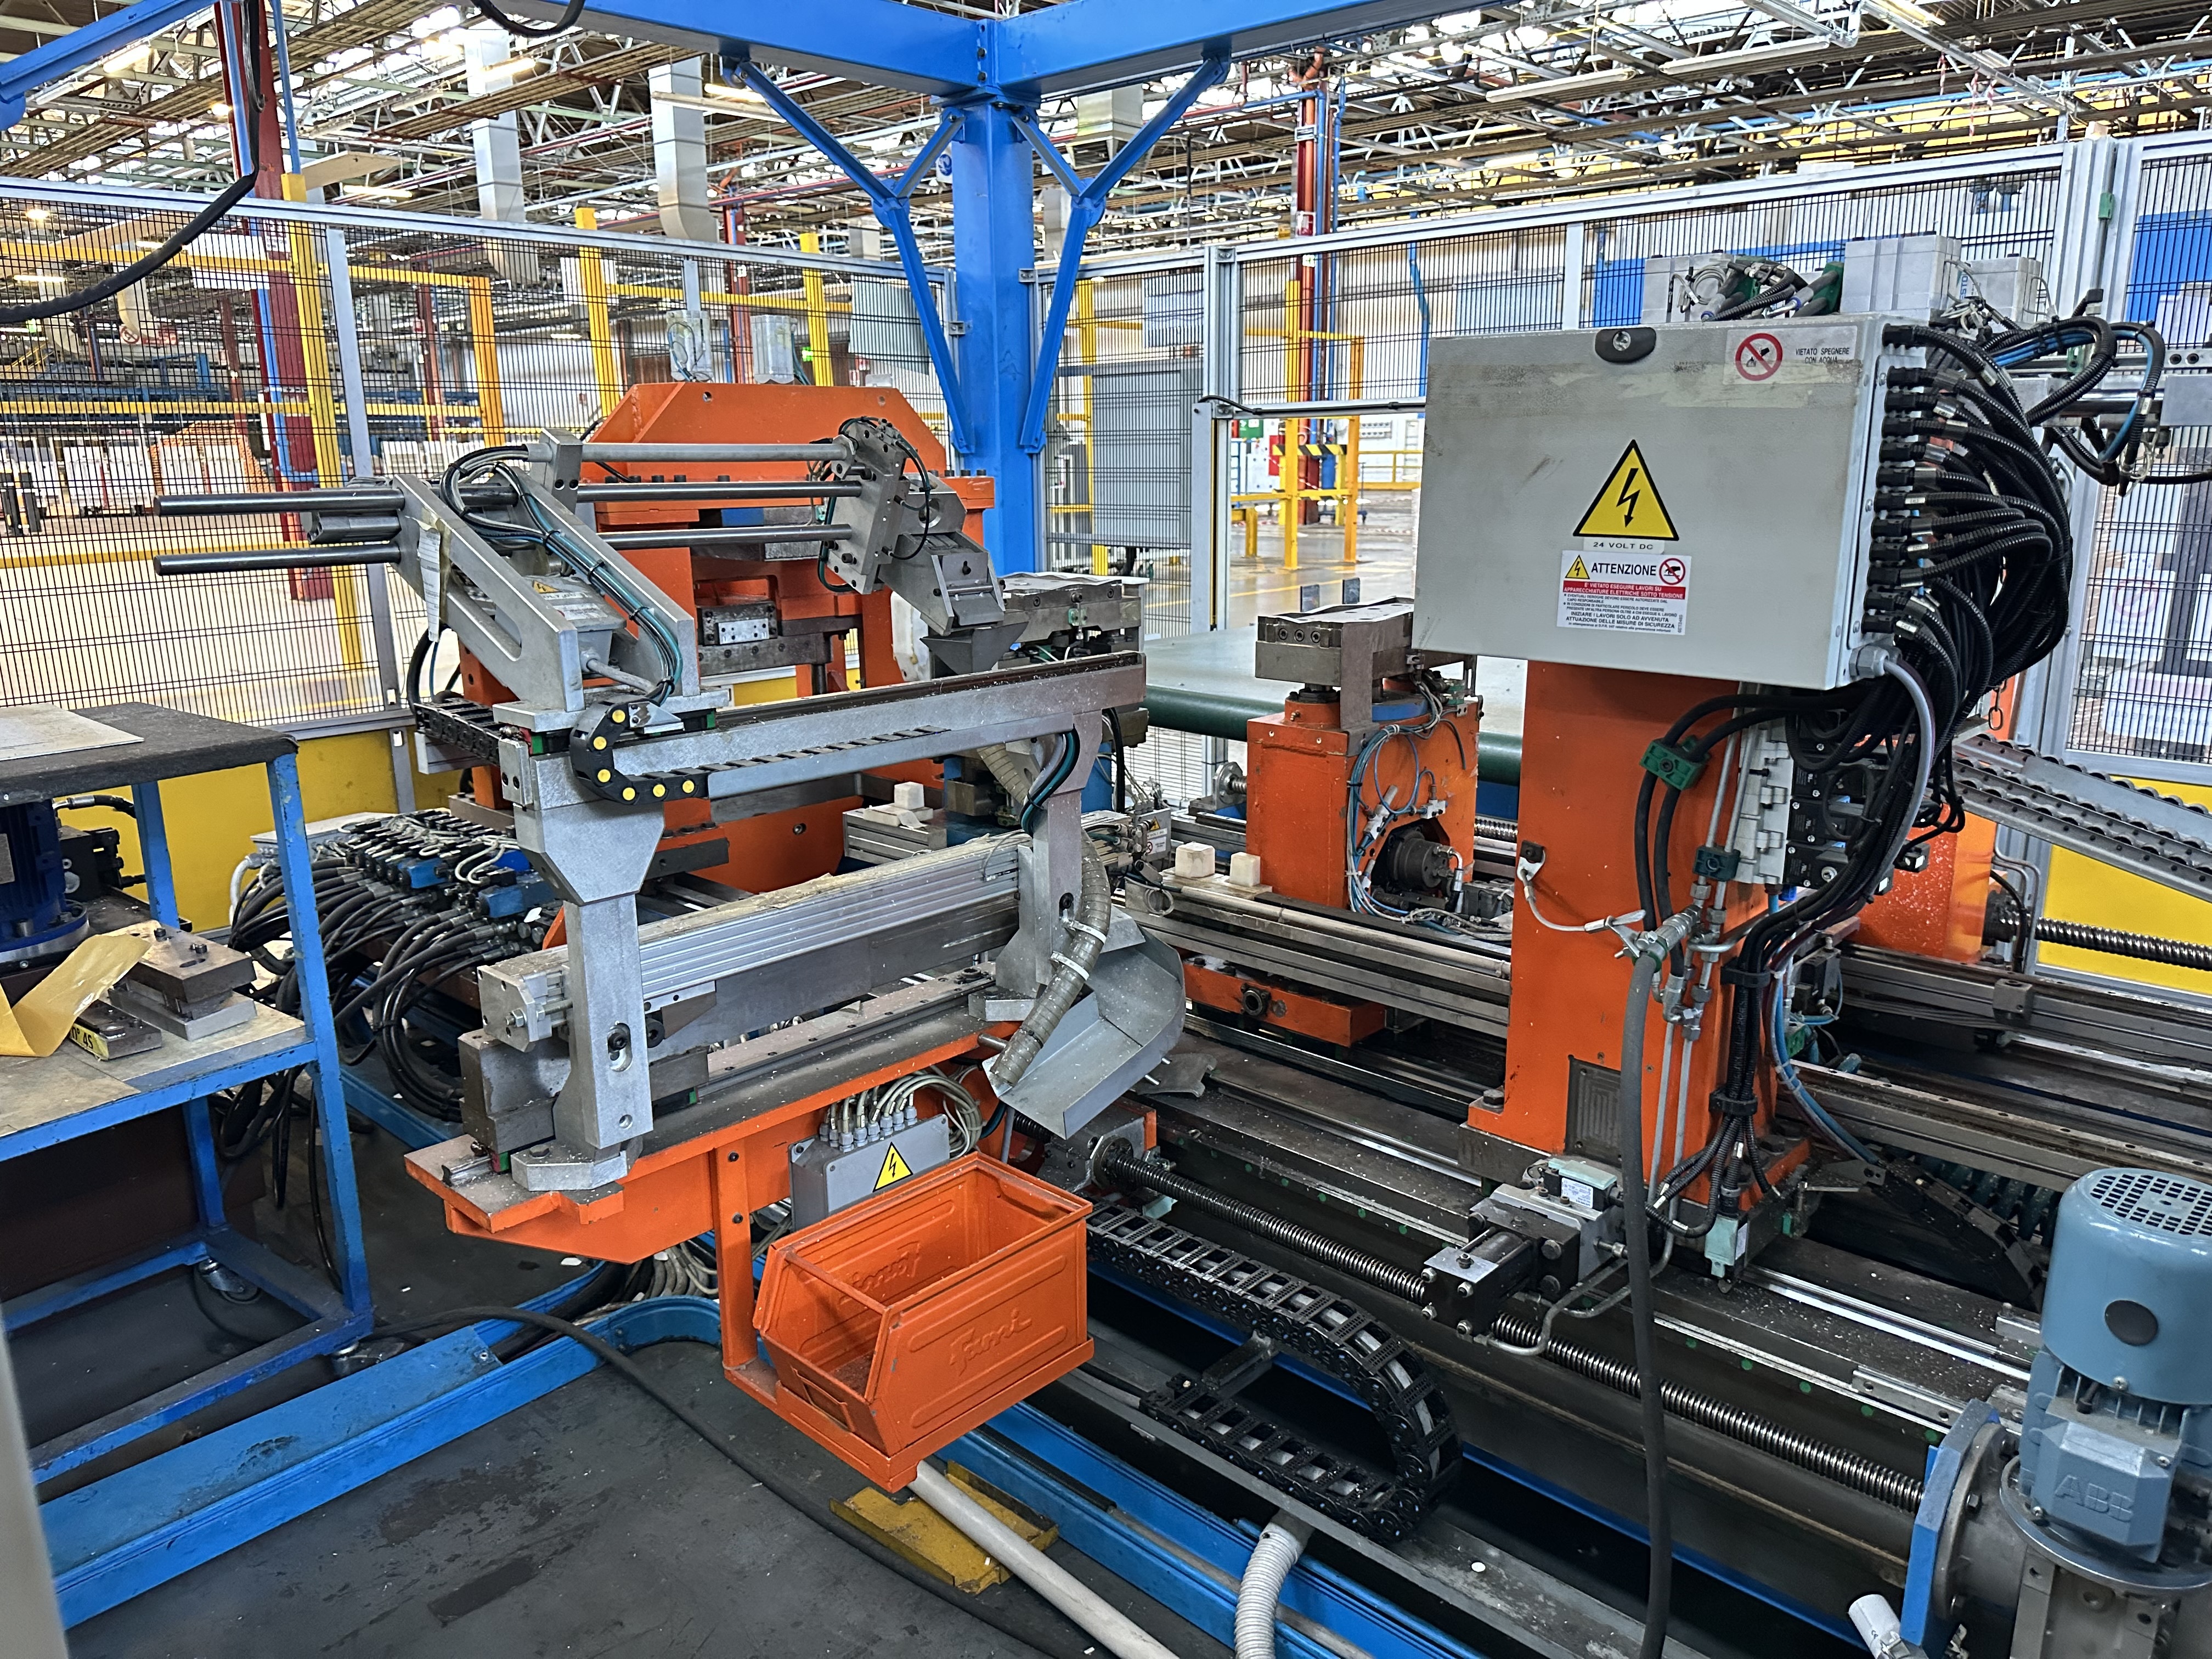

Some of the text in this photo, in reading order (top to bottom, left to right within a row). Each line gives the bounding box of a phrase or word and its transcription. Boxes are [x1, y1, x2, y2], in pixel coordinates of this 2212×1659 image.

[1960, 275, 1968, 301] ESTO
[1591, 562, 1657, 576] ATTENZIONE
[950, 1308, 1032, 1377] Fami
[2055, 1475, 2134, 1522] ABB
